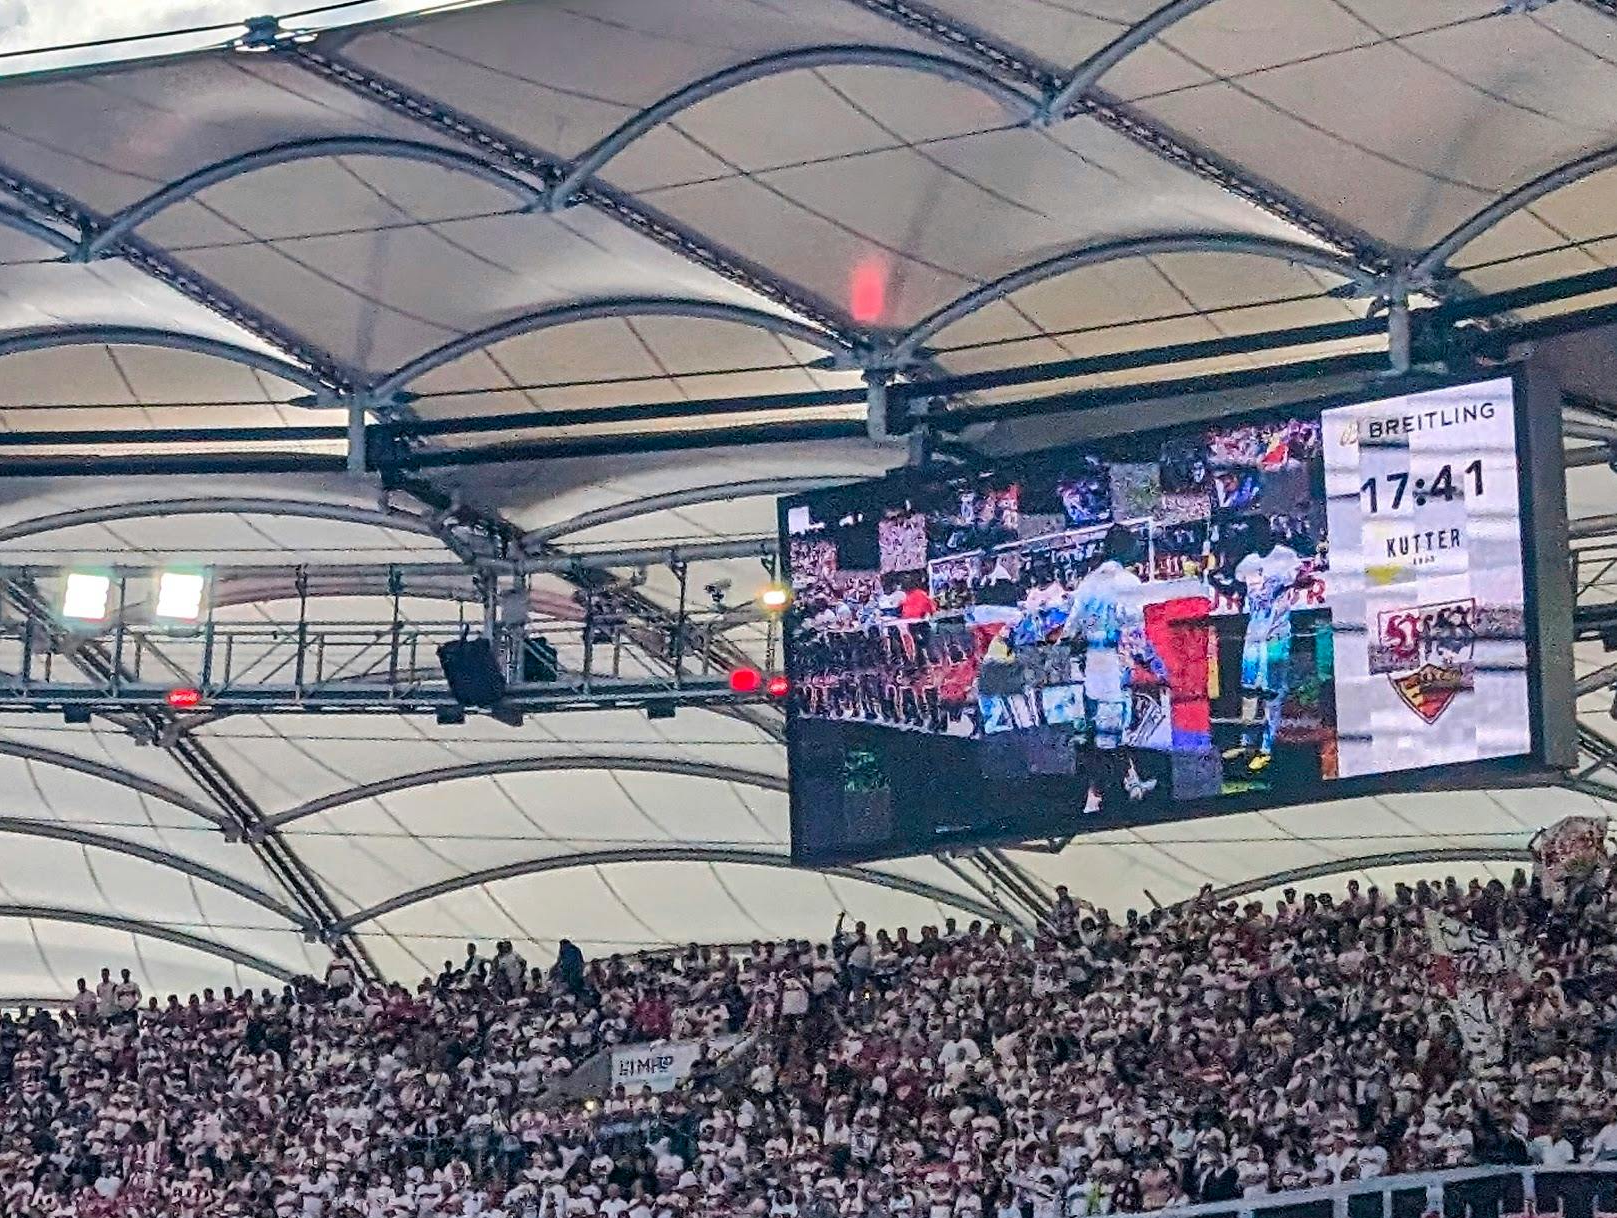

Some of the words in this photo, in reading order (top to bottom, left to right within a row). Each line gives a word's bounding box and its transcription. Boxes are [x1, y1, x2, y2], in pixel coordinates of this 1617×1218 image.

[1370, 403, 1495, 438] BREITLING
[1361, 460, 1483, 513] 17:41
[1386, 528, 1460, 557] KUTTER
